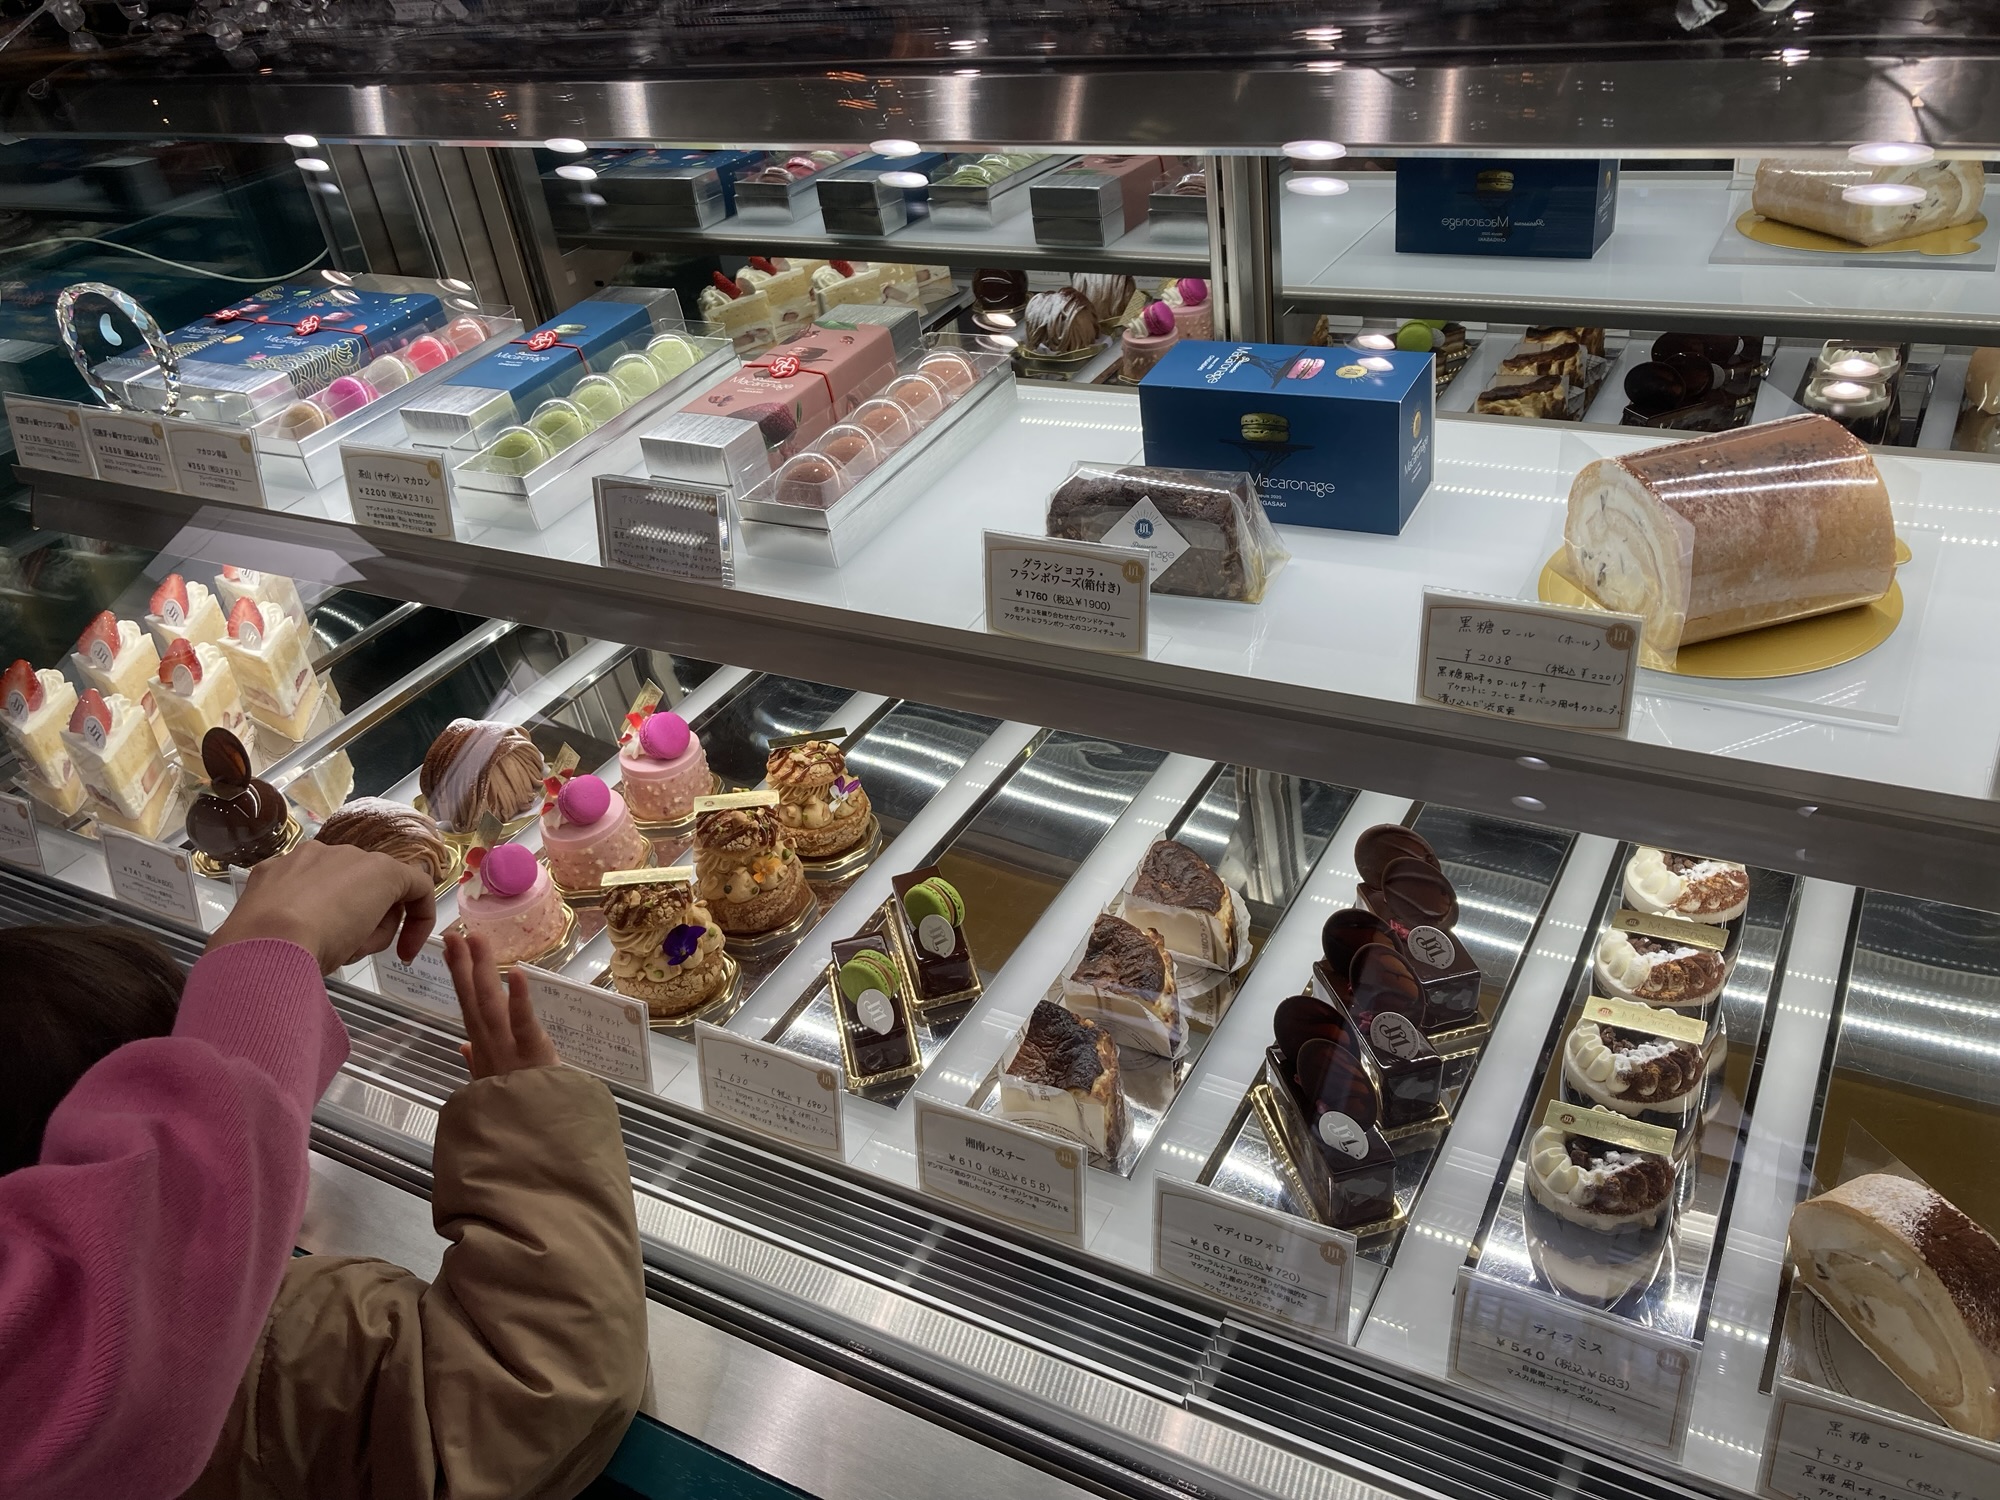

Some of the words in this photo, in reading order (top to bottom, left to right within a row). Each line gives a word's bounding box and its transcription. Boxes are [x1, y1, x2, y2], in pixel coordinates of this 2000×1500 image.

[359, 487, 387, 498] ¥2200
[1016, 588, 1048, 601] ¥1760
[1053, 594, 1111, 612] (税込¥1900)
[1458, 615, 1535, 638] 黒糖ロール
[1557, 634, 1600, 651] (ホール)
[740, 1052, 769, 1069] オペラ
[949, 1153, 982, 1171] ¥610
[988, 1165, 1051, 1193] (税込¥658)
[1213, 1223, 1285, 1254] マディロフォロ
[1190, 1236, 1231, 1258] ¥667
[1238, 1253, 1301, 1283] (税込¥720)
[1219, 1280, 1273, 1302] ガナッシュケーキ
[1533, 1323, 1603, 1355] ティラミス
[1496, 1336, 1545, 1361] ¥540
[1554, 1357, 1630, 1392] (税込¥583)
[1522, 1364, 1603, 1397] 自家製コーヒーゼリー
[1506, 1367, 1617, 1414] マスカルポーネチーズのムース
[1826, 1420, 1924, 1460] 黒糖ロール
